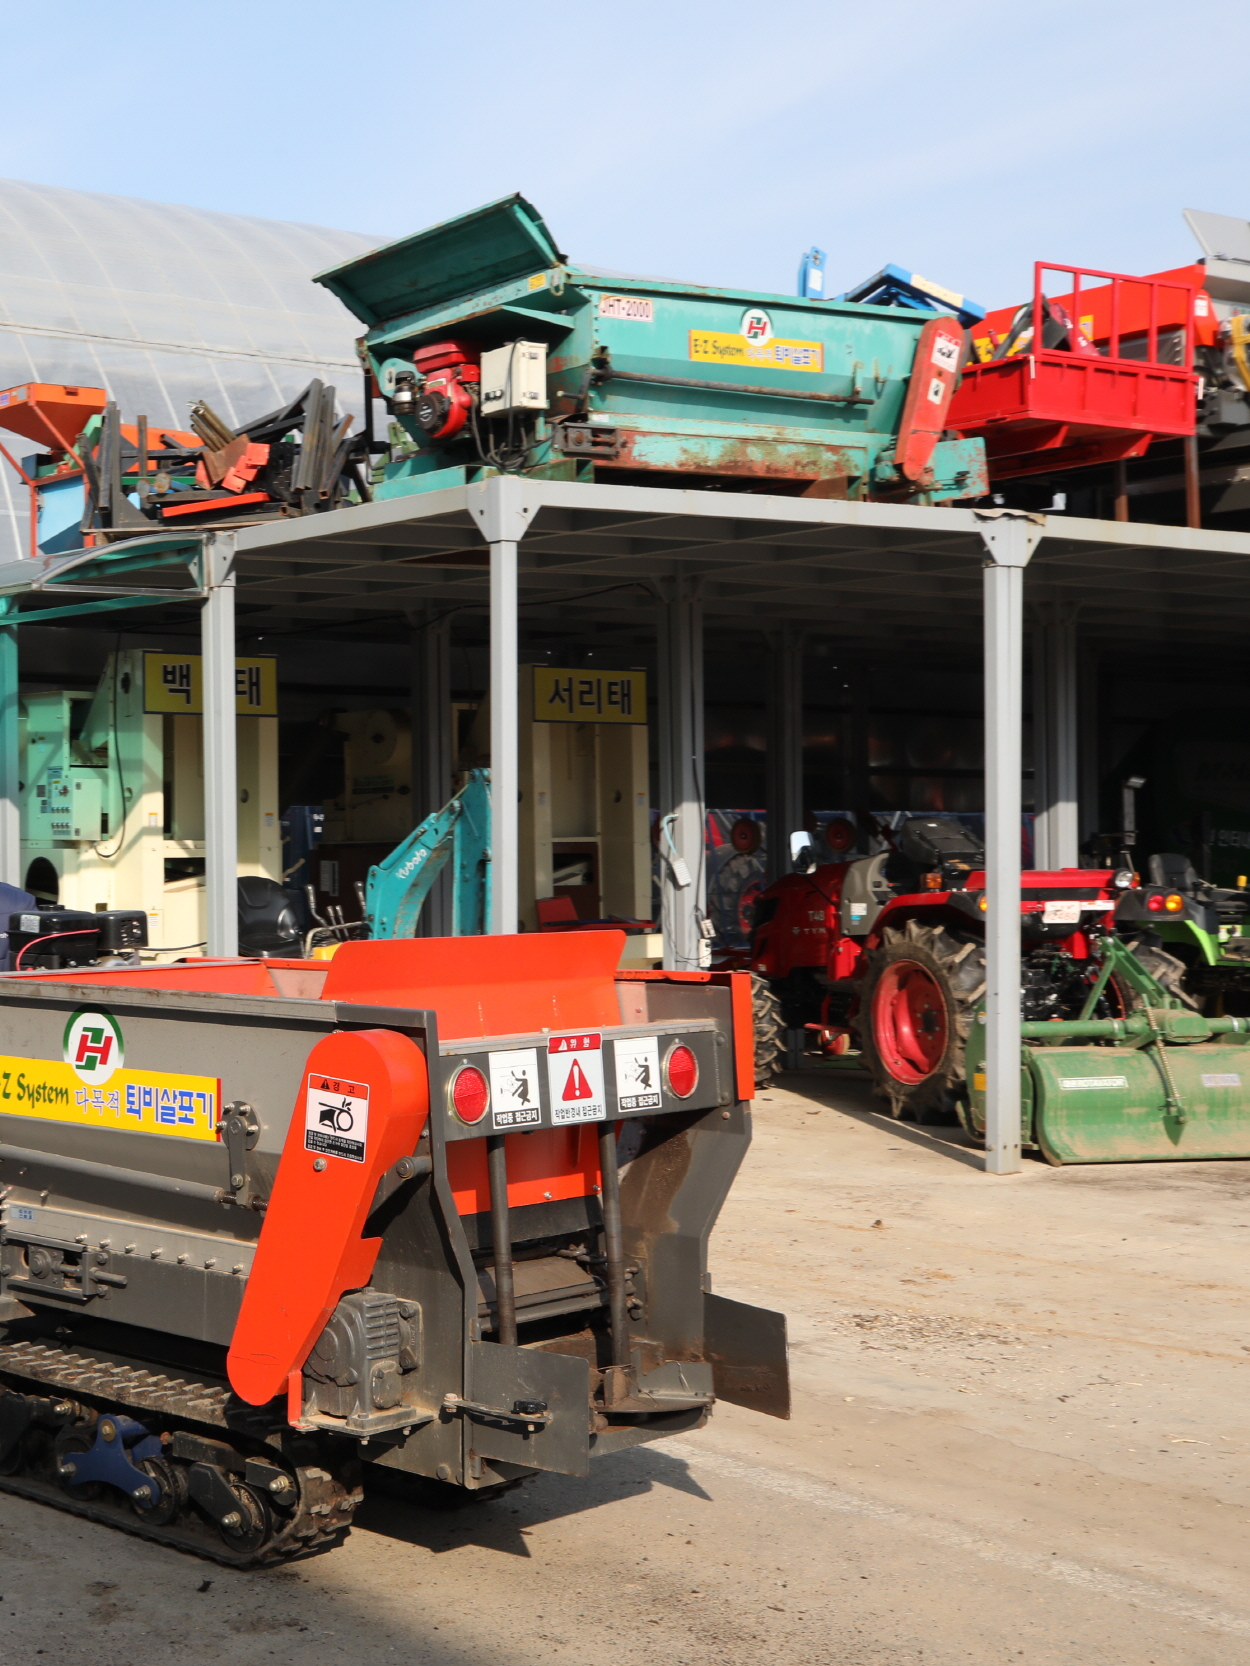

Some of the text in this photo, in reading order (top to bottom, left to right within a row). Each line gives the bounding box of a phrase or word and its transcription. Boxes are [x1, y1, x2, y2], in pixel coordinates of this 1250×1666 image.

[601, 298, 650, 318] JHT-2000
[712, 340, 744, 359] System
[162, 663, 261, 706] 백태
[548, 676, 632, 715] 서리태
[395, 849, 428, 879] Kubota
[569, 1037, 590, 1049] 위험
[333, 1081, 355, 1094] 경고
[17, 1072, 69, 1109] System
[74, 1086, 120, 1117] 다목적
[126, 1084, 214, 1130] 퇴비살포기
[582, 1104, 602, 1117] 접근금지
[620, 1094, 658, 1108] 작업중 접근금지
[496, 1109, 537, 1124] 작업중 접근금지
